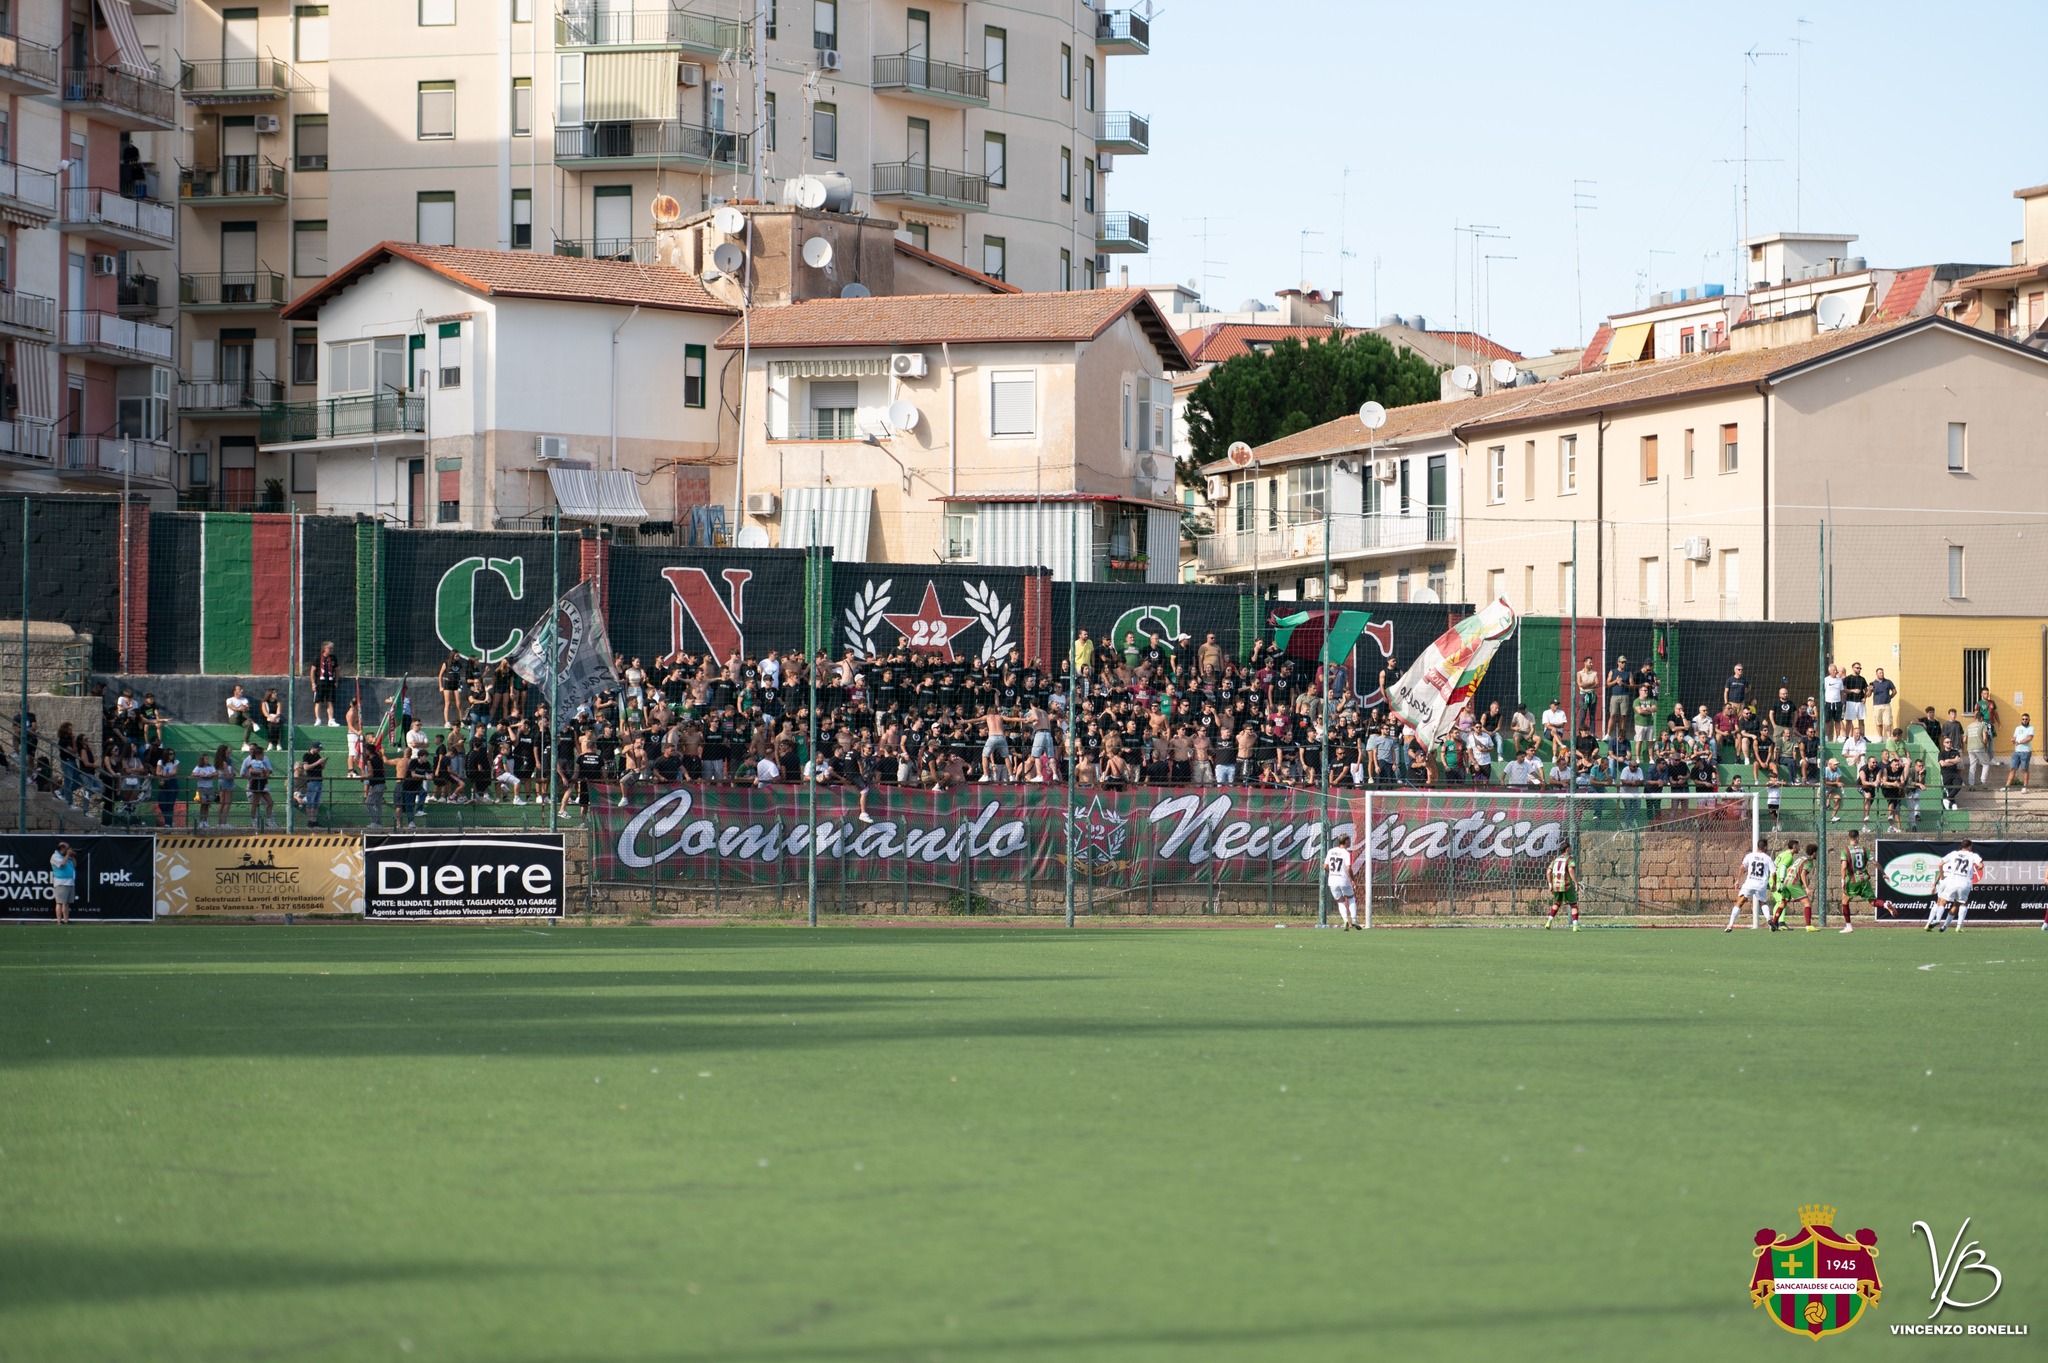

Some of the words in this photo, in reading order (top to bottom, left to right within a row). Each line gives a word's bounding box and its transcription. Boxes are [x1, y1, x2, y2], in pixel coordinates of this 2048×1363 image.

[911, 620, 948, 646] 22
[617, 789, 1028, 868] Commando
[1148, 793, 1562, 876] Neuropatico
[1330, 857, 1343, 872] 37
[1855, 853, 1863, 868] 8
[1955, 858, 1969, 874] 72
[100, 869, 130, 884] ppk
[1751, 861, 1765, 877] 13
[216, 872, 239, 884] SAN
[246, 871, 299, 884] MICHELE
[215, 885, 300, 894] COSTRUZIONI
[397, 900, 433, 908] BLINDATE,
[466, 899, 516, 907] TAGLIAFUOCO,
[529, 898, 557, 906] GARAGE
[1988, 901, 2008, 911] Style
[372, 908, 396, 917] Agente
[405, 908, 432, 916] vendita:
[462, 908, 492, 917] Vivacqua
[498, 907, 514, 915] info:
